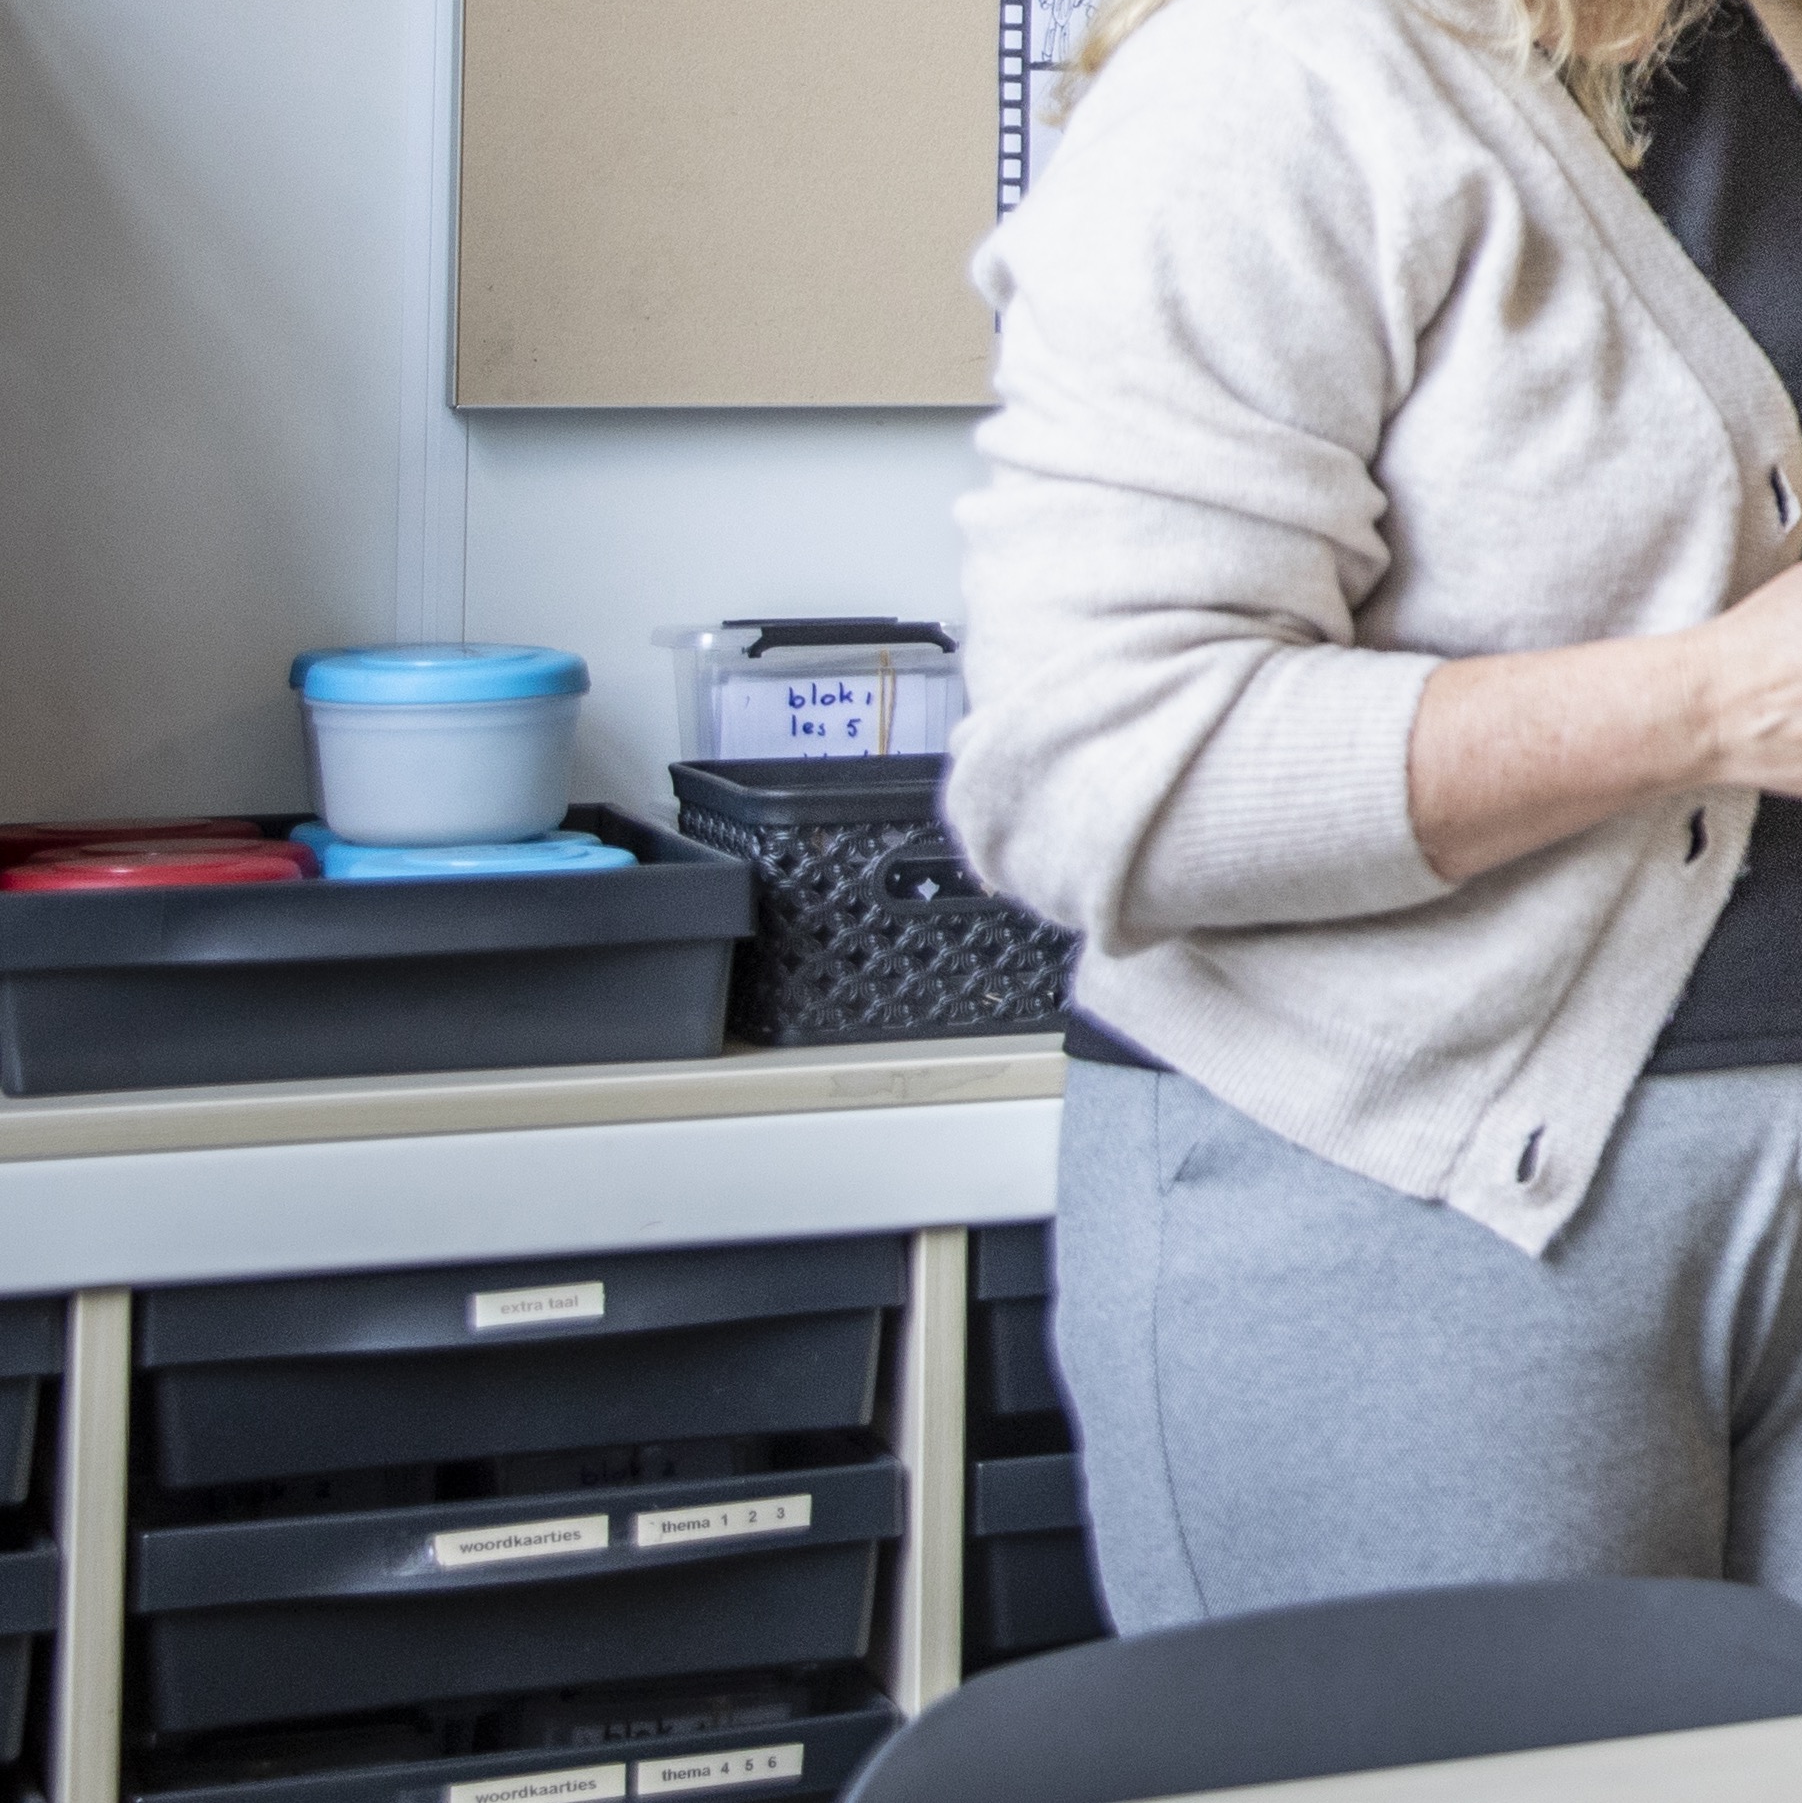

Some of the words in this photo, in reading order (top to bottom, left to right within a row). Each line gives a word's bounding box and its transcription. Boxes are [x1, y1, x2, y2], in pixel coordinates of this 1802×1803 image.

[788, 681, 854, 709] blok
[791, 714, 827, 738] les
[847, 717, 862, 738] 5
[501, 1300, 544, 1315] extra
[548, 1295, 580, 1309] taal
[661, 1516, 712, 1535] thema
[721, 1513, 729, 1527] 1
[748, 1510, 758, 1524] 2
[776, 1506, 786, 1521] 3
[661, 1764, 711, 1783] thema
[719, 1761, 730, 1776] 4
[744, 1758, 754, 1772] 5
[767, 1755, 777, 1770] 6
